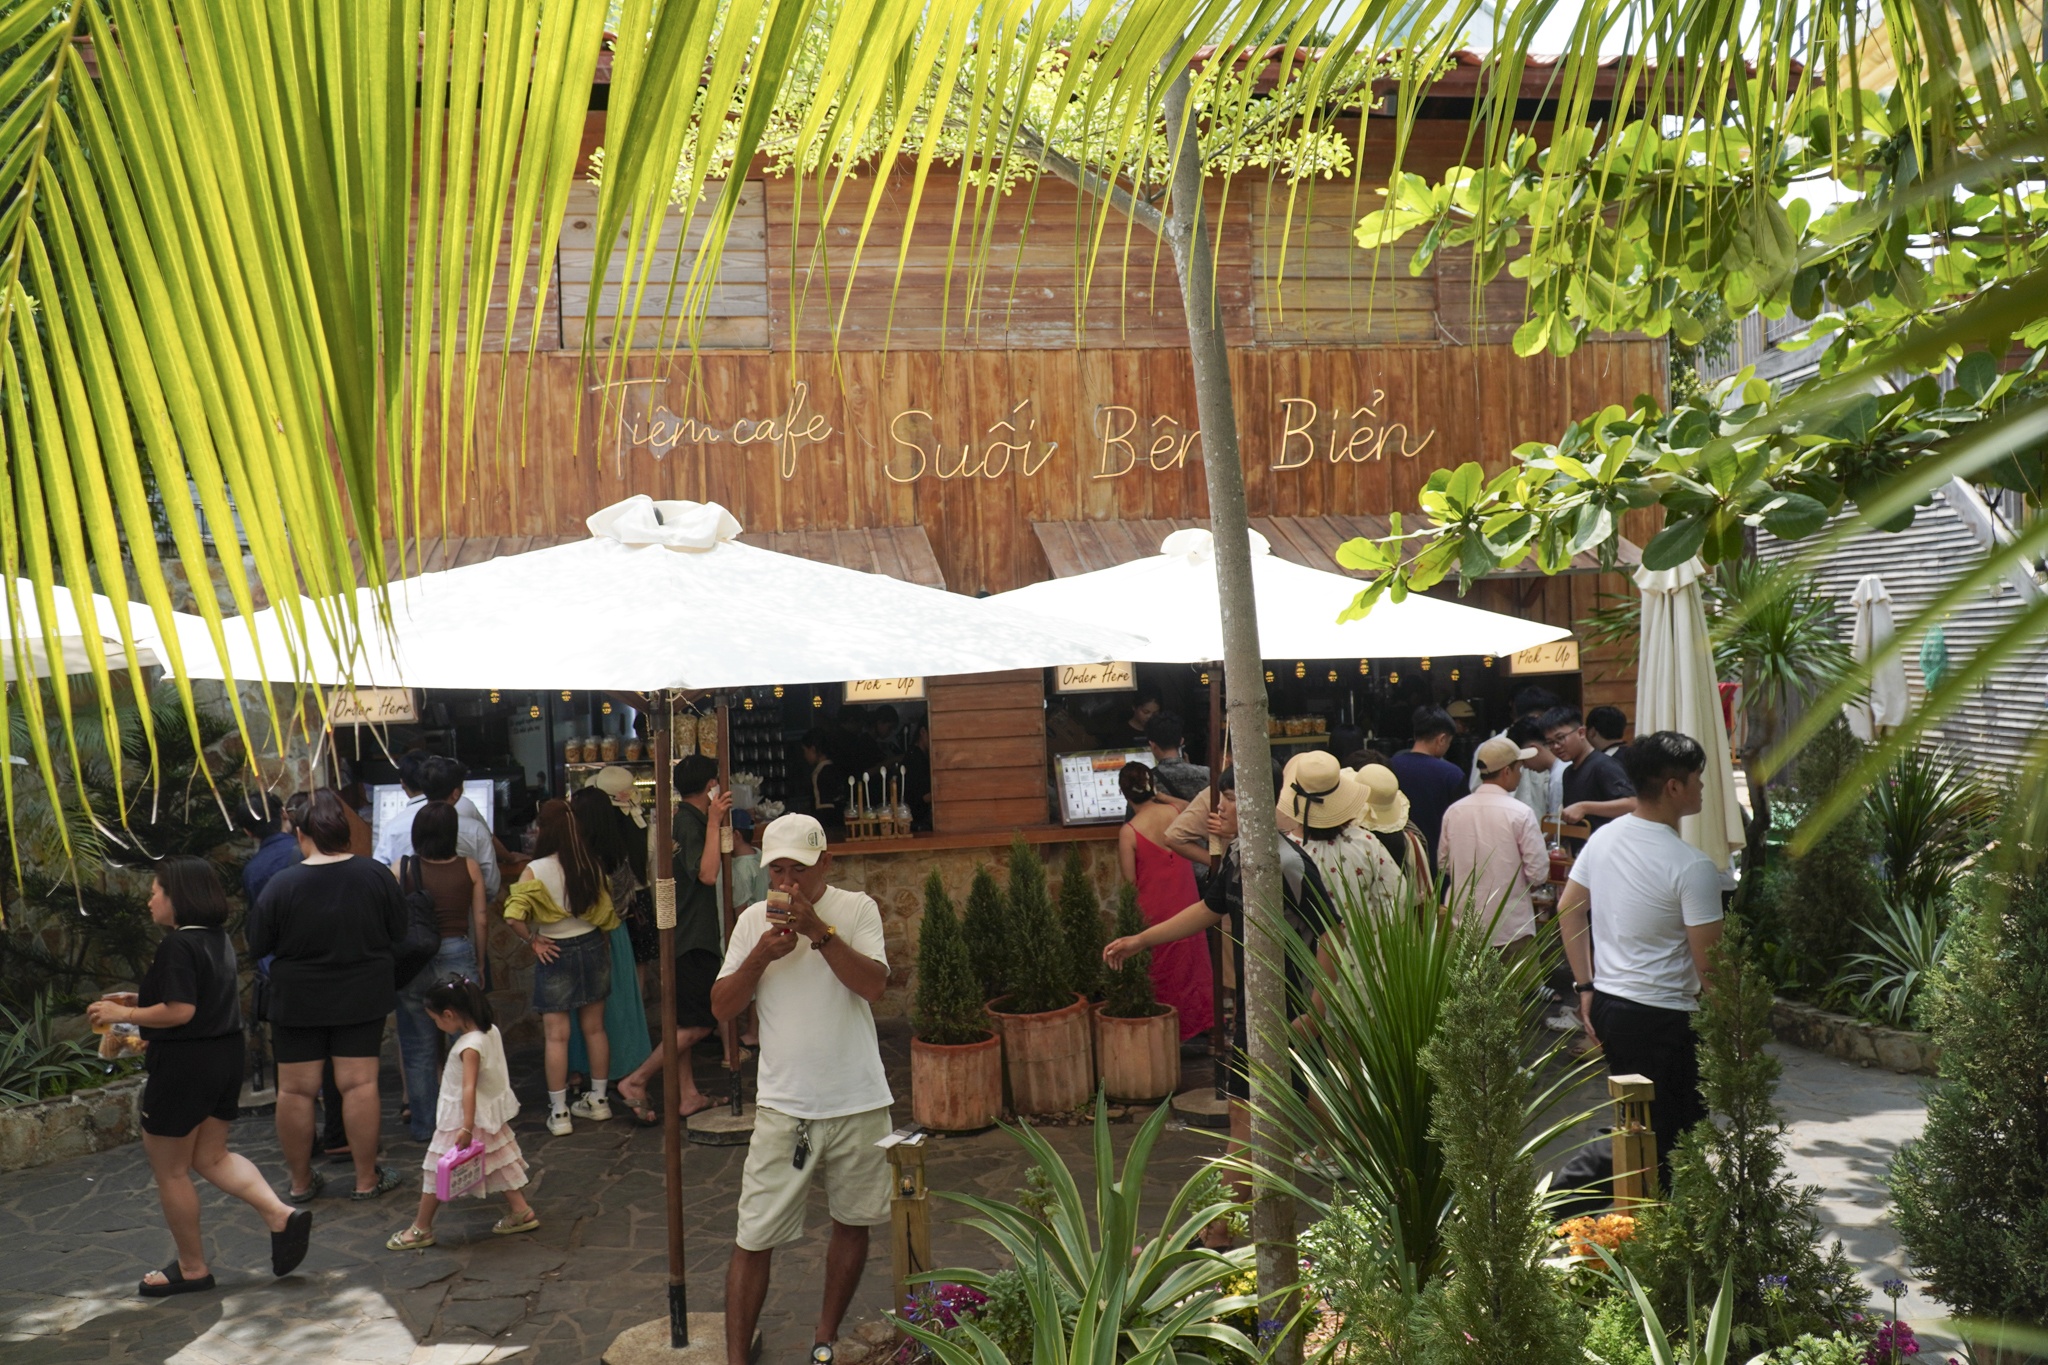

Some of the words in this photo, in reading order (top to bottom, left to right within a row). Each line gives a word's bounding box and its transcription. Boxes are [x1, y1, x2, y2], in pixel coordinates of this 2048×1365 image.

[590, 379, 720, 478] Tiệm
[733, 382, 833, 479] cafe
[884, 399, 1056, 482] Suối
[1272, 389, 1435, 471] Biển
[1517, 646, 1542, 665] Pick
[1554, 645, 1570, 668] Up
[1063, 666, 1097, 685] Order
[1101, 664, 1130, 683] Here
[897, 677, 915, 695] Up
[378, 695, 411, 716] Here
